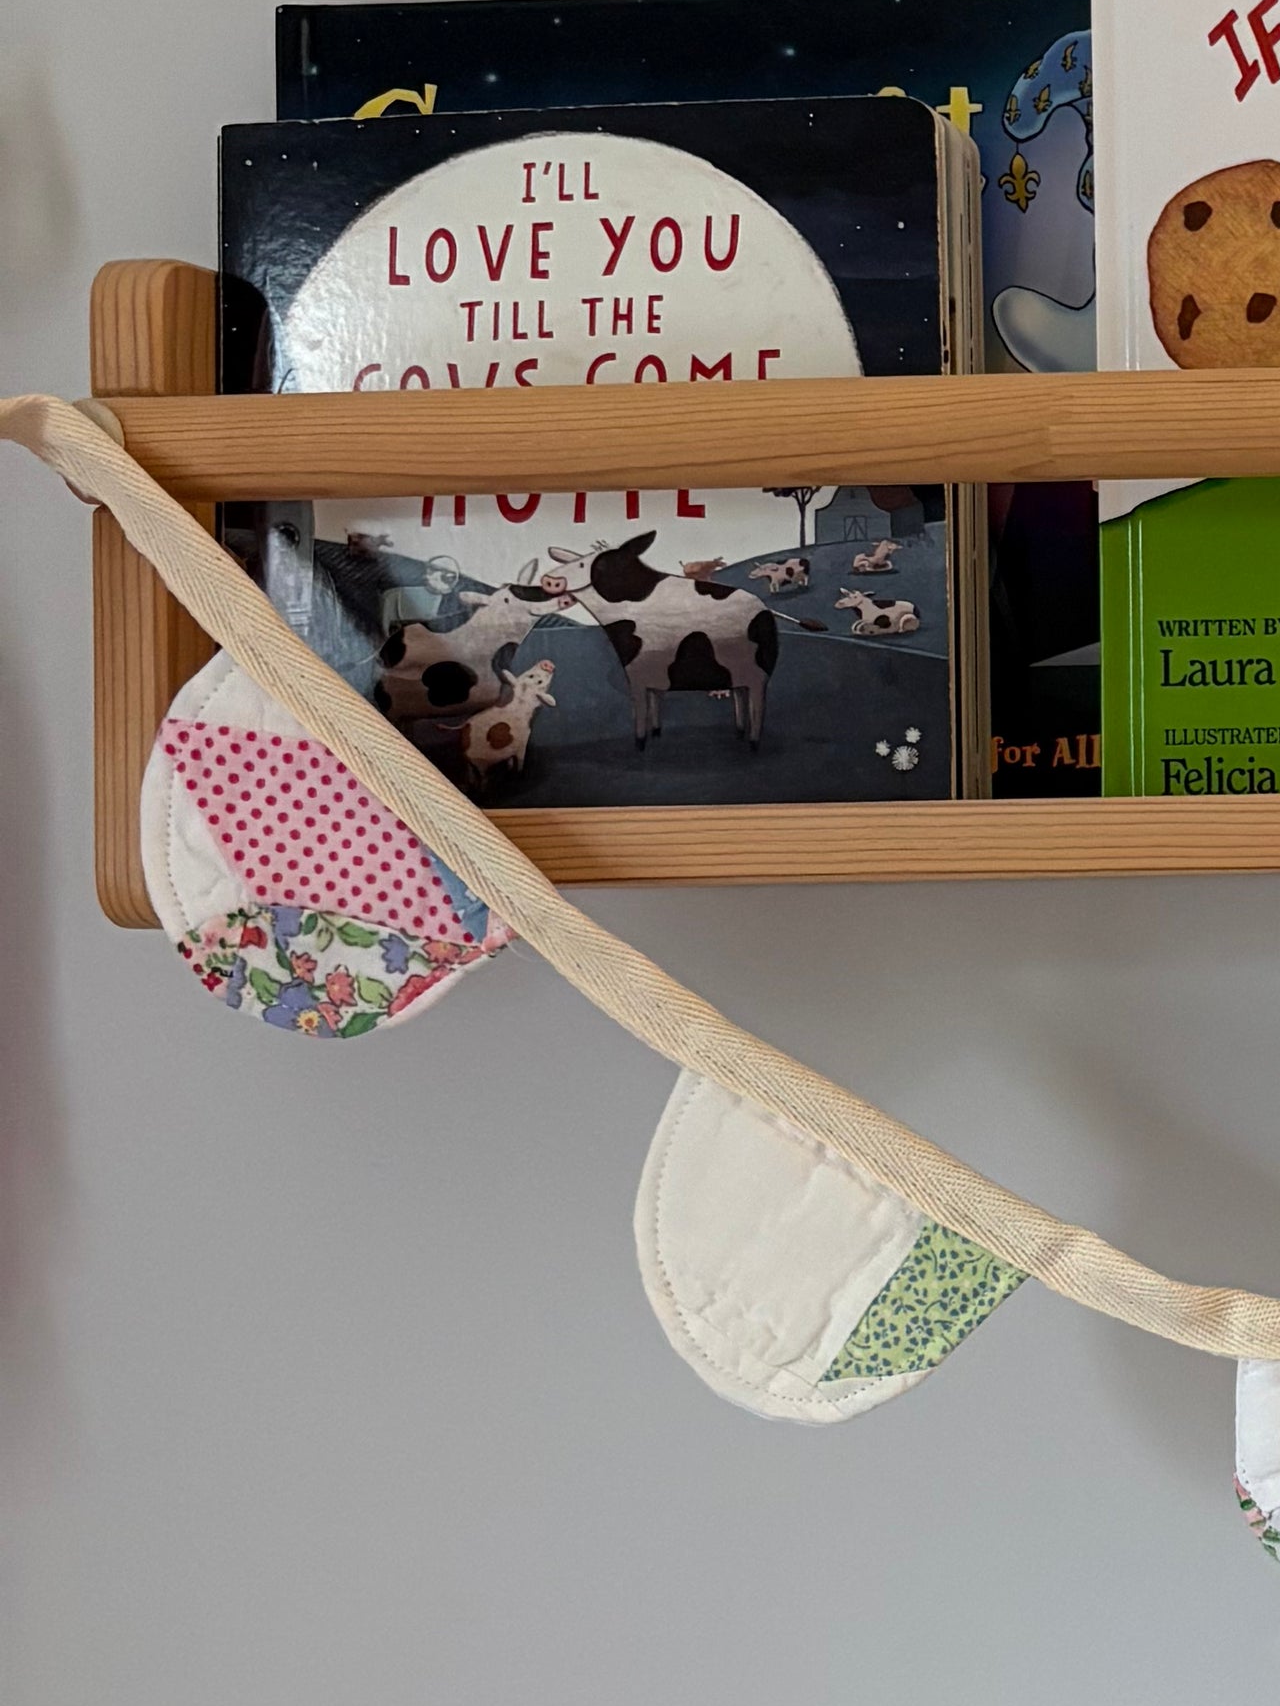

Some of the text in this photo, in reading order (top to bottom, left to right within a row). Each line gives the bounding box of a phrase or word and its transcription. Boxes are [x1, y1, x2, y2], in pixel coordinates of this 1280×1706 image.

[522, 161, 599, 203] I'LL
[389, 214, 739, 285] LOVE YOU
[460, 294, 664, 342] TILL THE
[1158, 618, 1257, 638] WRITTEN
[1160, 649, 1276, 688] Laura
[990, 736, 1041, 773] for
[1161, 757, 1278, 795] Felicia
